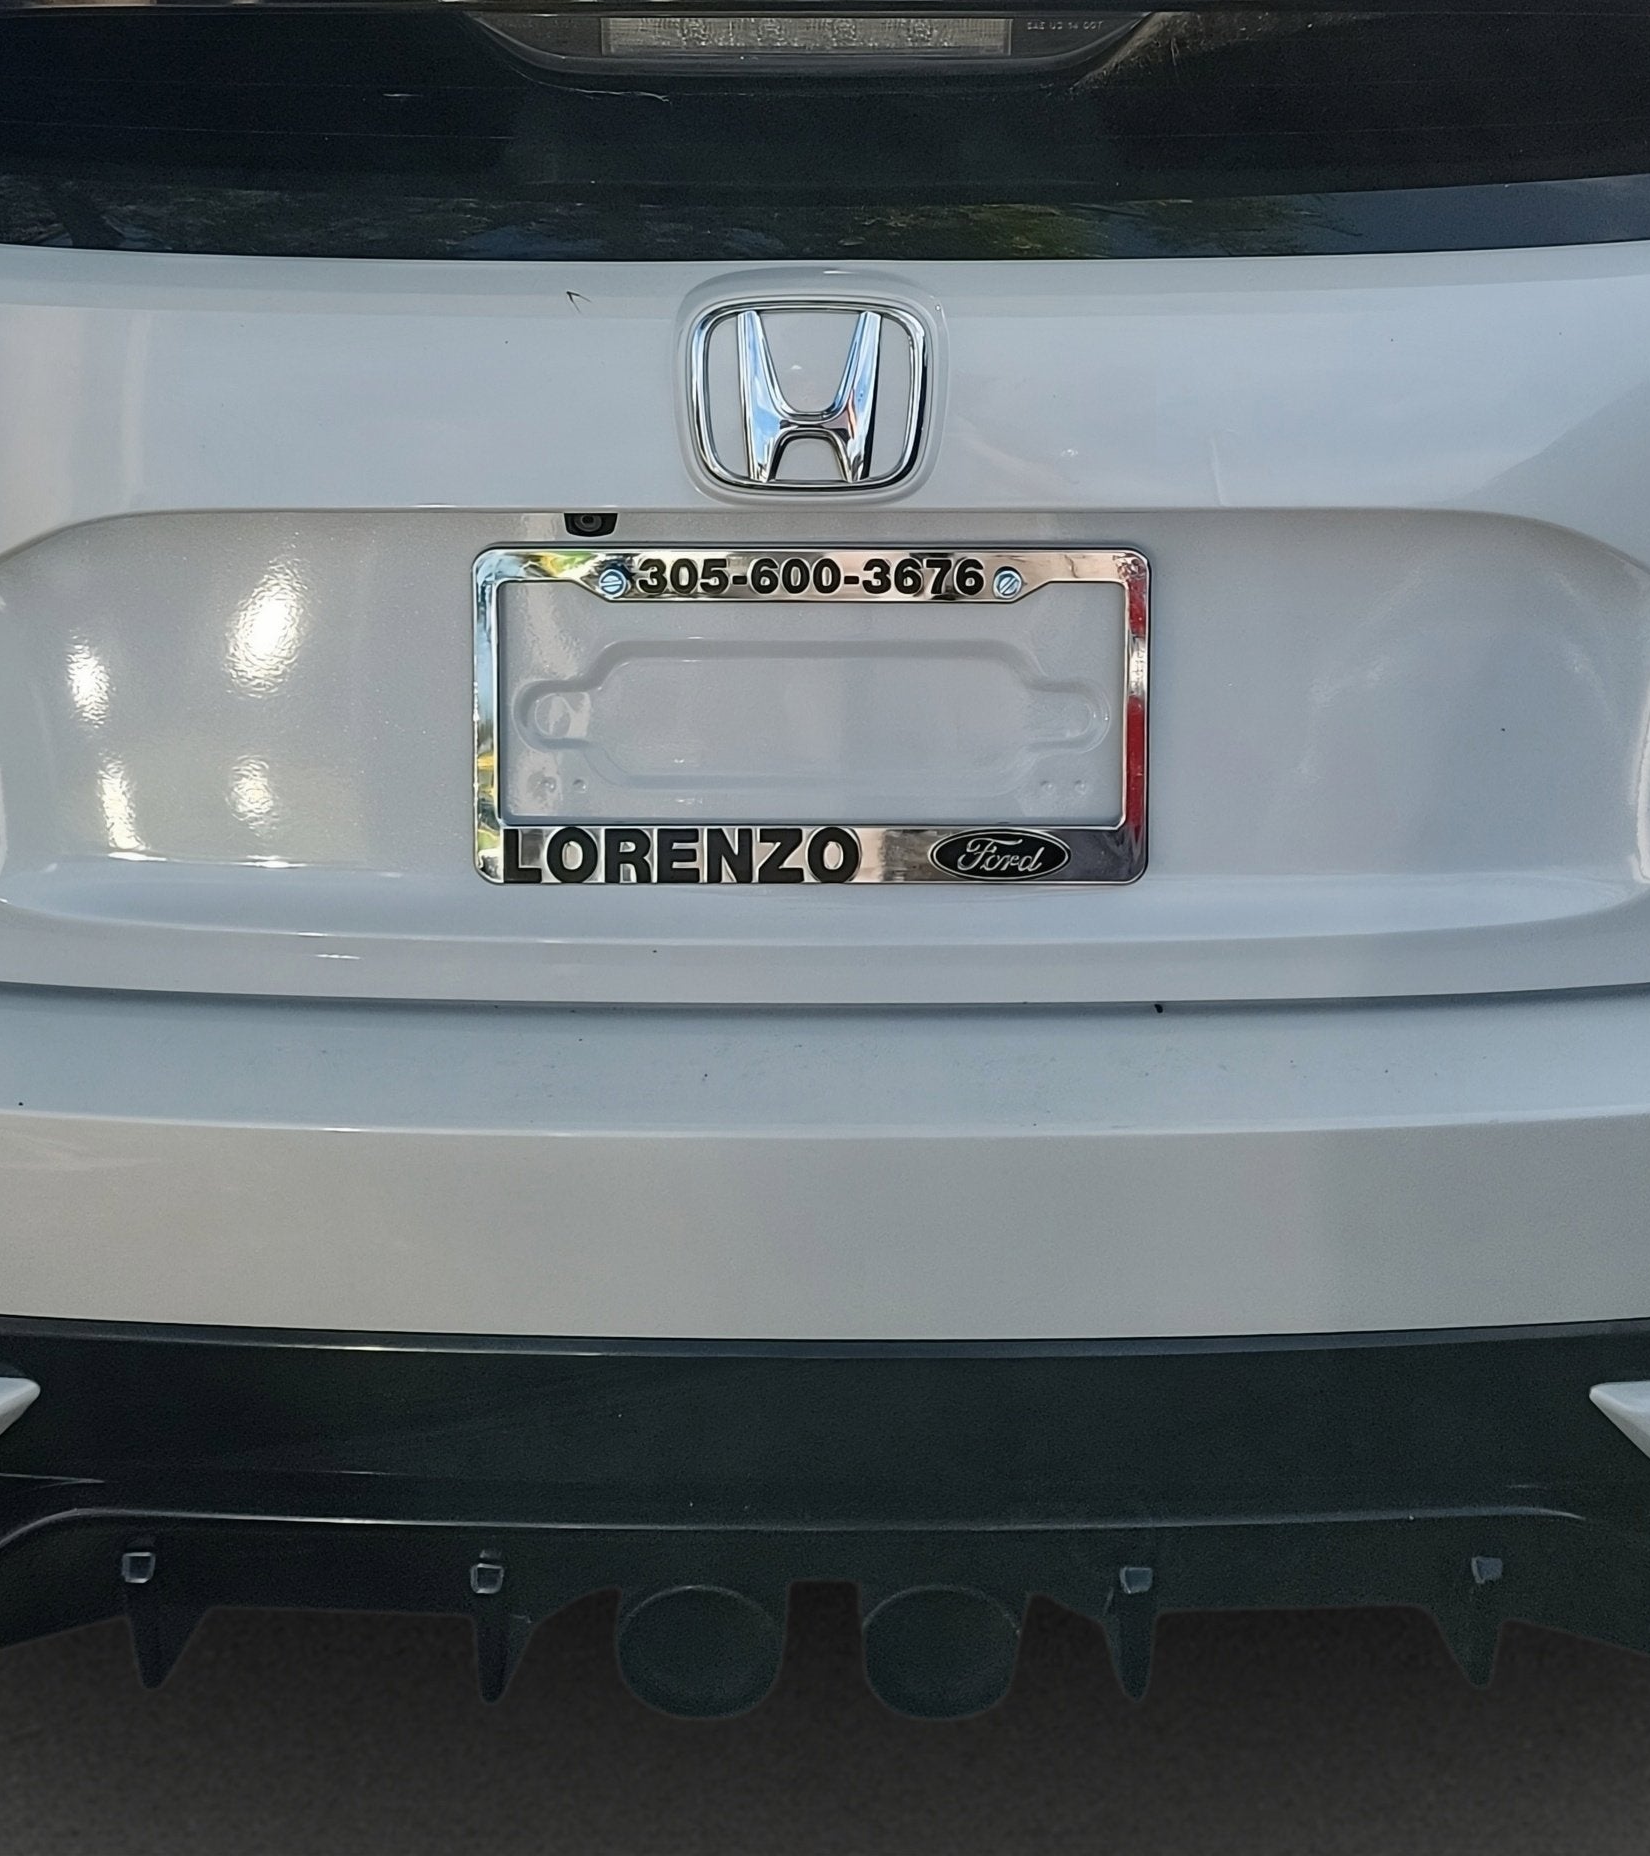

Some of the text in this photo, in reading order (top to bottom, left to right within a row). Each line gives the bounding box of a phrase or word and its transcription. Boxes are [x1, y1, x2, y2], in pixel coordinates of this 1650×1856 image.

[637, 558, 986, 595] 305-600-3676
[502, 827, 1043, 884] LORENZO Ford
